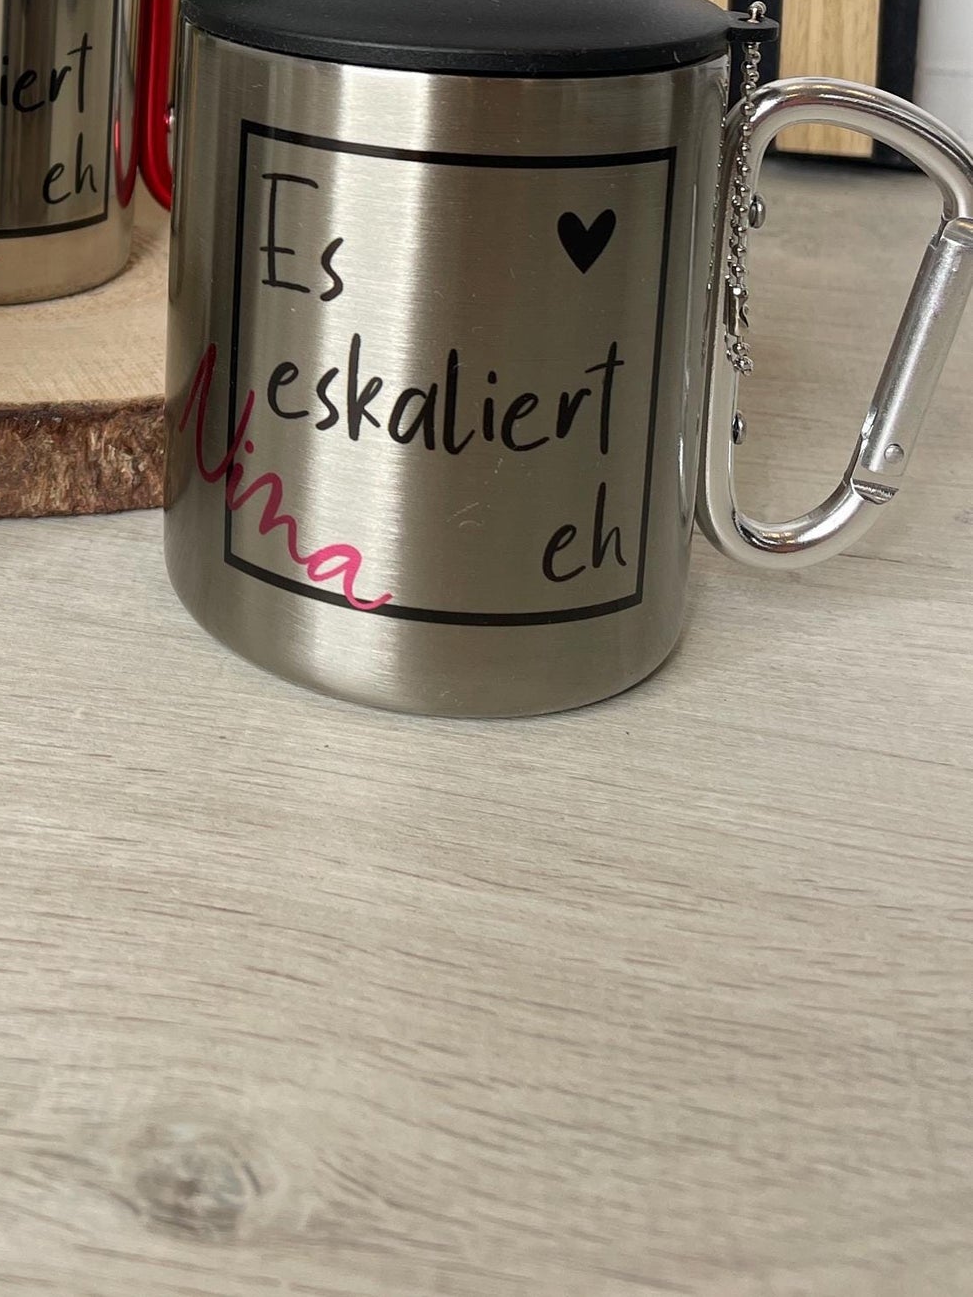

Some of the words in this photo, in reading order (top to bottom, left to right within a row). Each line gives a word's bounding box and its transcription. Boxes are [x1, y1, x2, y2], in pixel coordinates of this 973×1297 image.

[42, 132, 97, 205] eh
[261, 173, 345, 302] Es
[268, 333, 625, 456] eskaliert
[542, 482, 627, 582] eh
